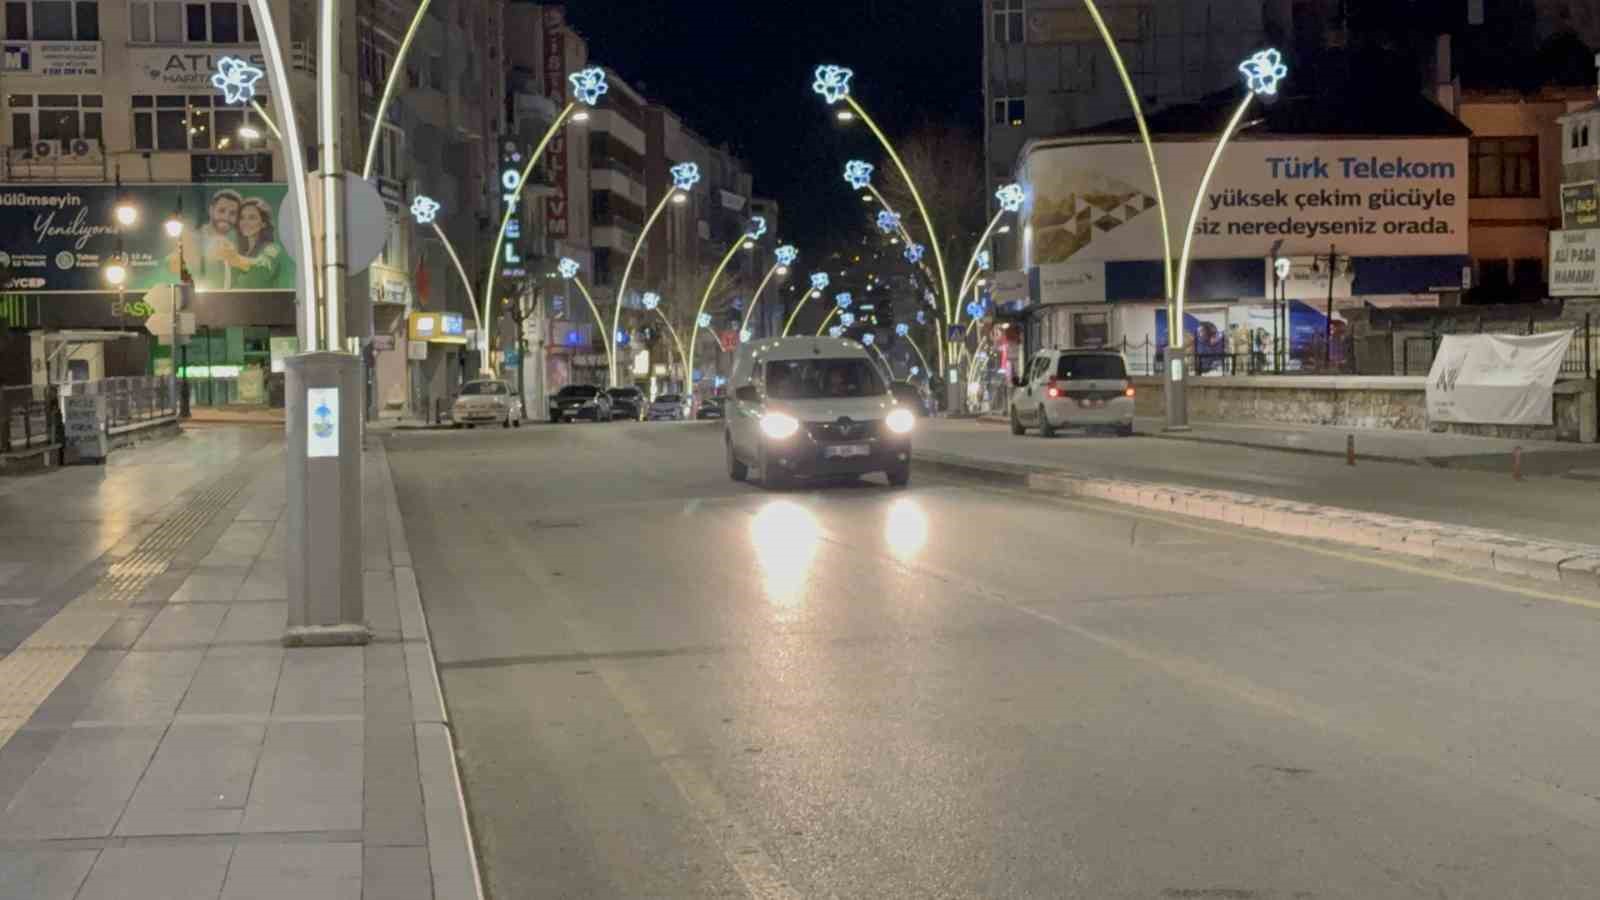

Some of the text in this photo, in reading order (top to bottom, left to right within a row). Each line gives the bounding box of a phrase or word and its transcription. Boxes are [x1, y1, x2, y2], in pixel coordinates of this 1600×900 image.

[1266, 156, 1455, 178] Türk Telekom
[0, 192, 80, 209] ülümseyin
[1209, 189, 1455, 211] yüksek çekim gücüyle
[1228, 216, 1377, 238] neredeyseniz
[1382, 217, 1455, 234] orada.
